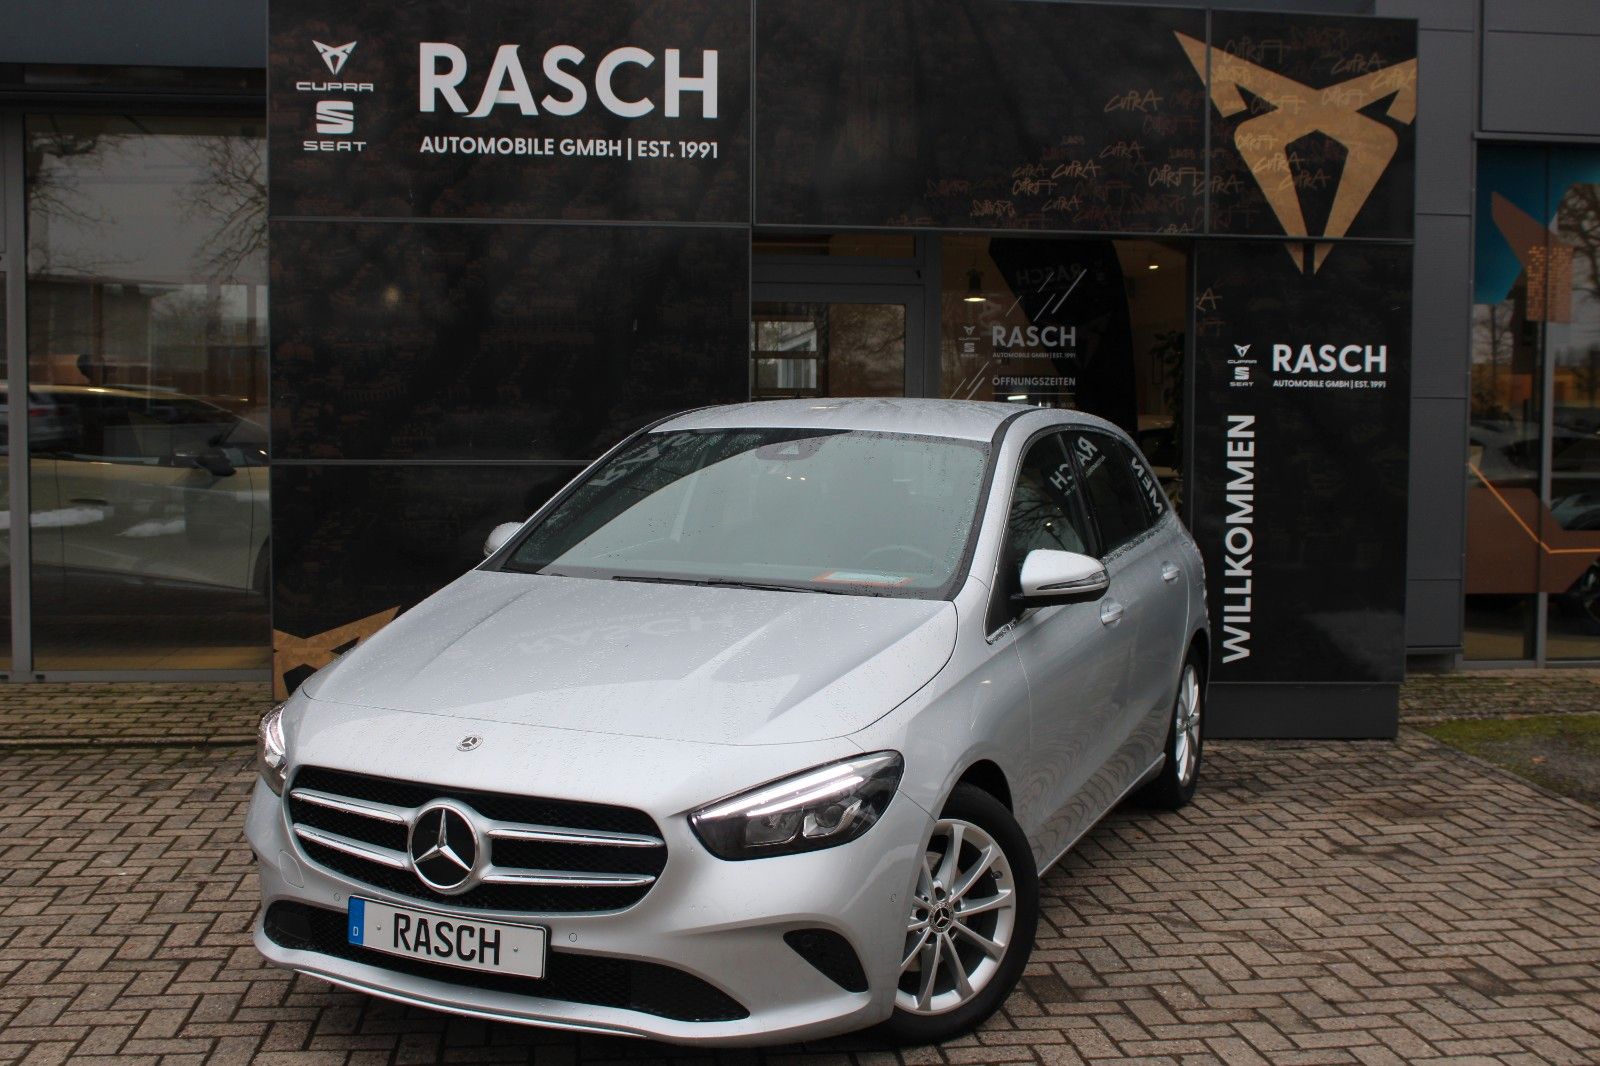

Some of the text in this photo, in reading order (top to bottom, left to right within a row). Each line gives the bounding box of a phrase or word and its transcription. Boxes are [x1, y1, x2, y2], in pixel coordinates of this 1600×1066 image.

[295, 81, 374, 92] CUPRA
[419, 42, 718, 118] RASCH
[303, 140, 367, 152] SEAT
[419, 136, 718, 159] AUTOMOBILE GMBH EST. 1991
[992, 326, 1076, 348] RASCH
[1272, 343, 1387, 374] RASCH
[1272, 379, 1324, 388] AUTOMOBILE
[1325, 380, 1350, 389] GMBH
[1222, 414, 1256, 664] WILLKOMMEN
[393, 912, 500, 965] RASCH
